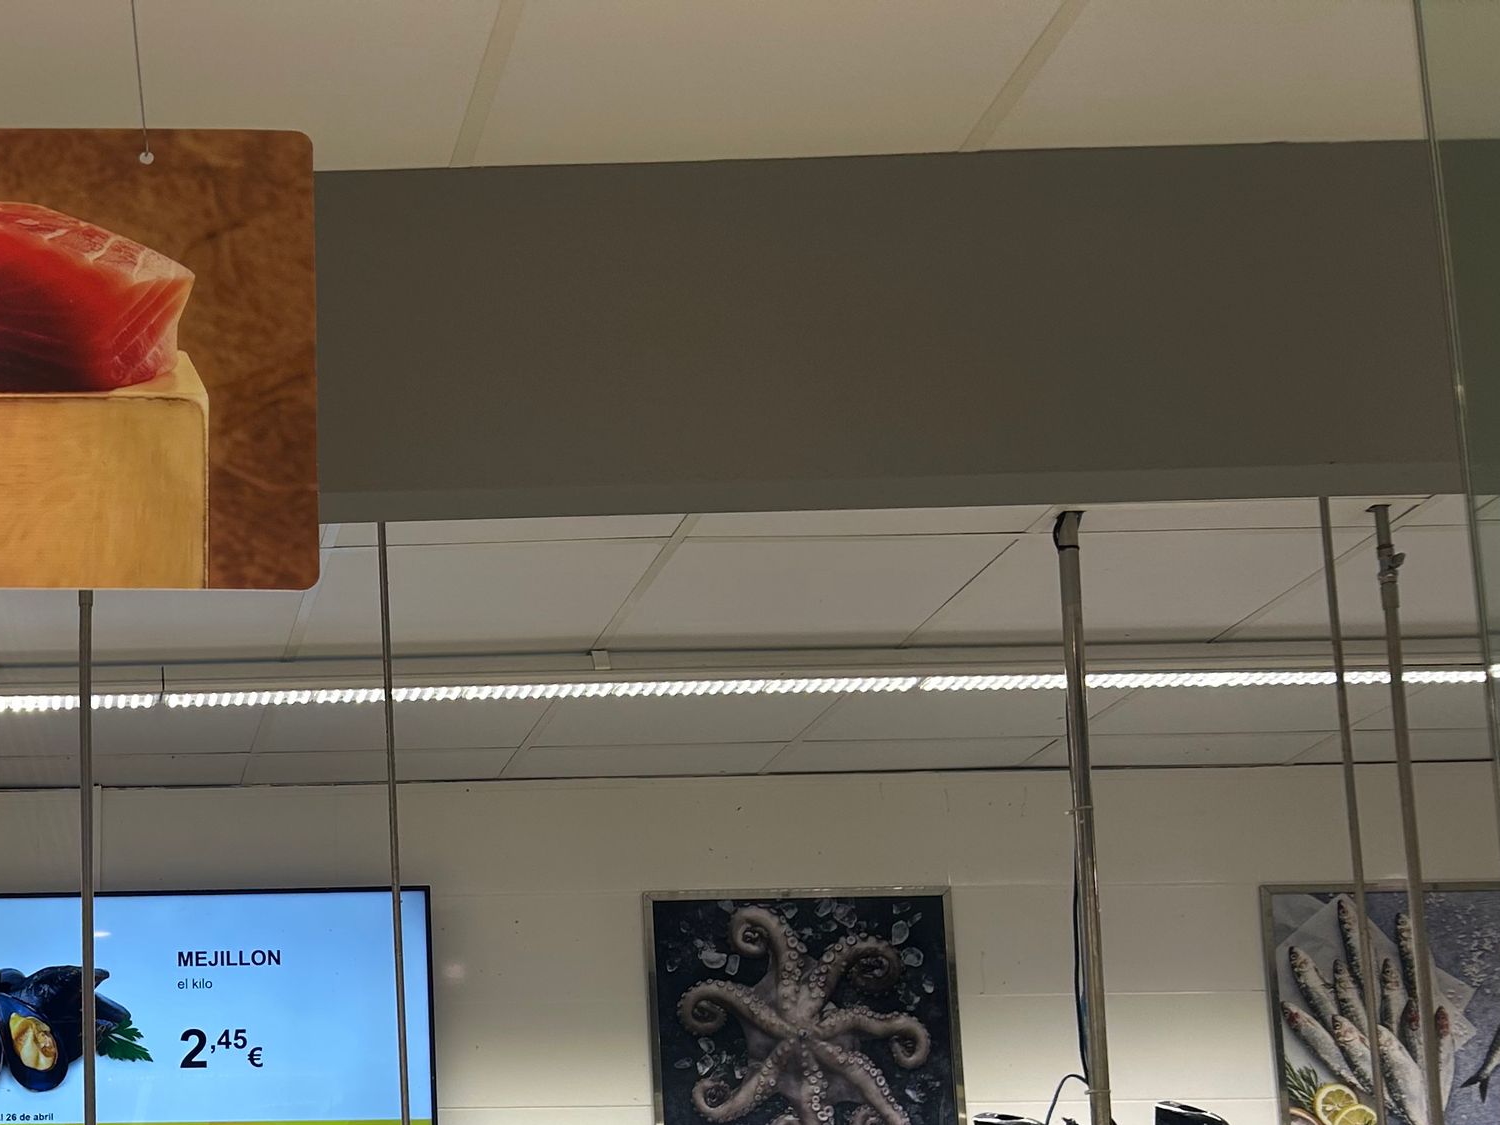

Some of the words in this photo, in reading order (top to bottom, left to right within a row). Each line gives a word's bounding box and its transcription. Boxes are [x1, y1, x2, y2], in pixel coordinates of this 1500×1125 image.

[177, 949, 281, 967] MEJILLON
[177, 978, 188, 989] el
[192, 978, 213, 989] kilo
[5, 1113, 17, 1122] 26
[19, 1113, 31, 1122] de
[33, 1112, 54, 1122] abril
